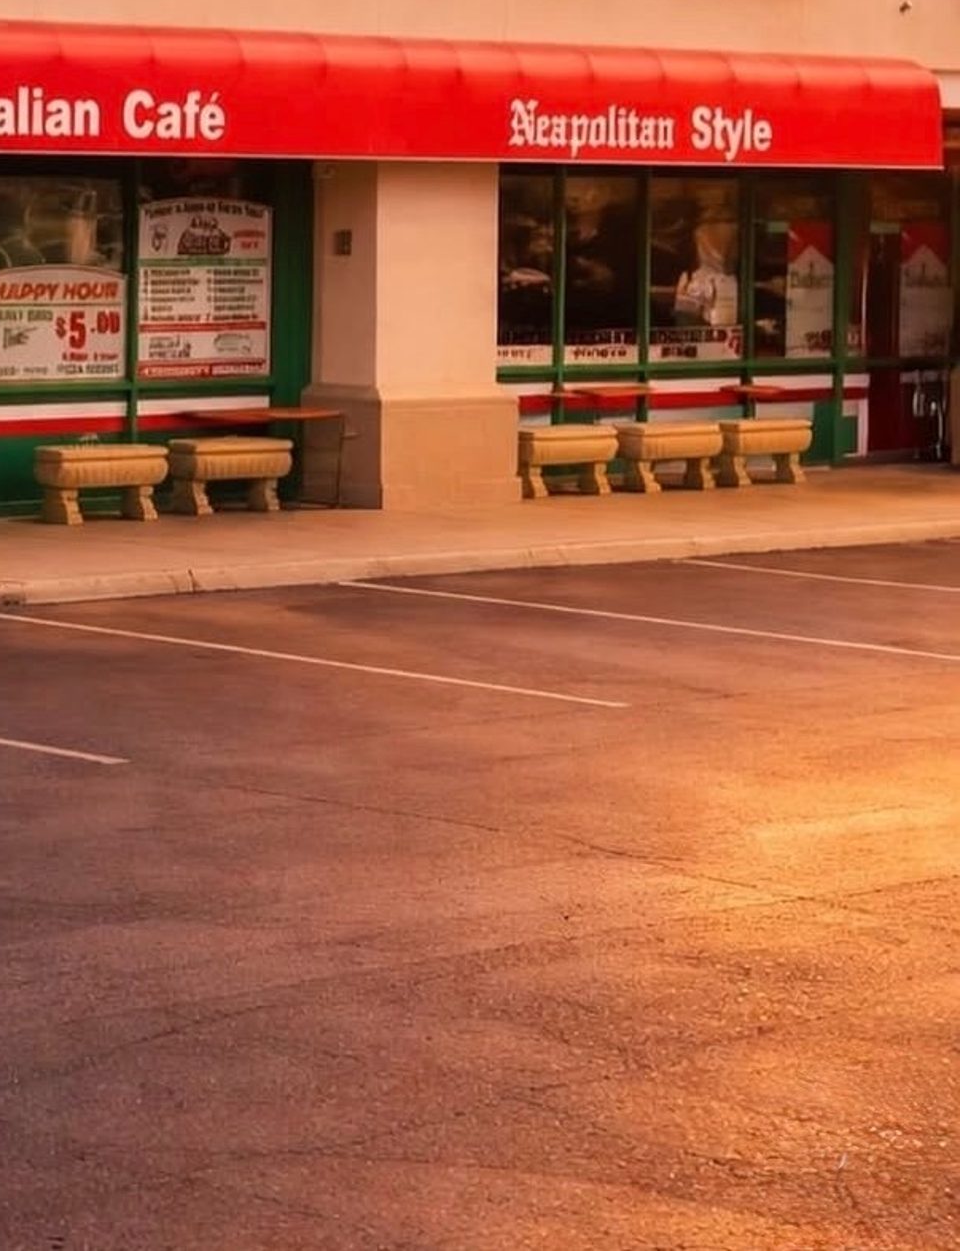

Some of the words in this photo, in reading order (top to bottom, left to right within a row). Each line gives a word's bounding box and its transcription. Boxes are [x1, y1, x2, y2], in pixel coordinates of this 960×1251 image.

[123, 89, 226, 139] Café
[509, 99, 675, 157] Neapolitan
[691, 105, 772, 161] Style
[63, 281, 119, 300] HOUR
[56, 310, 120, 350] $5.00
